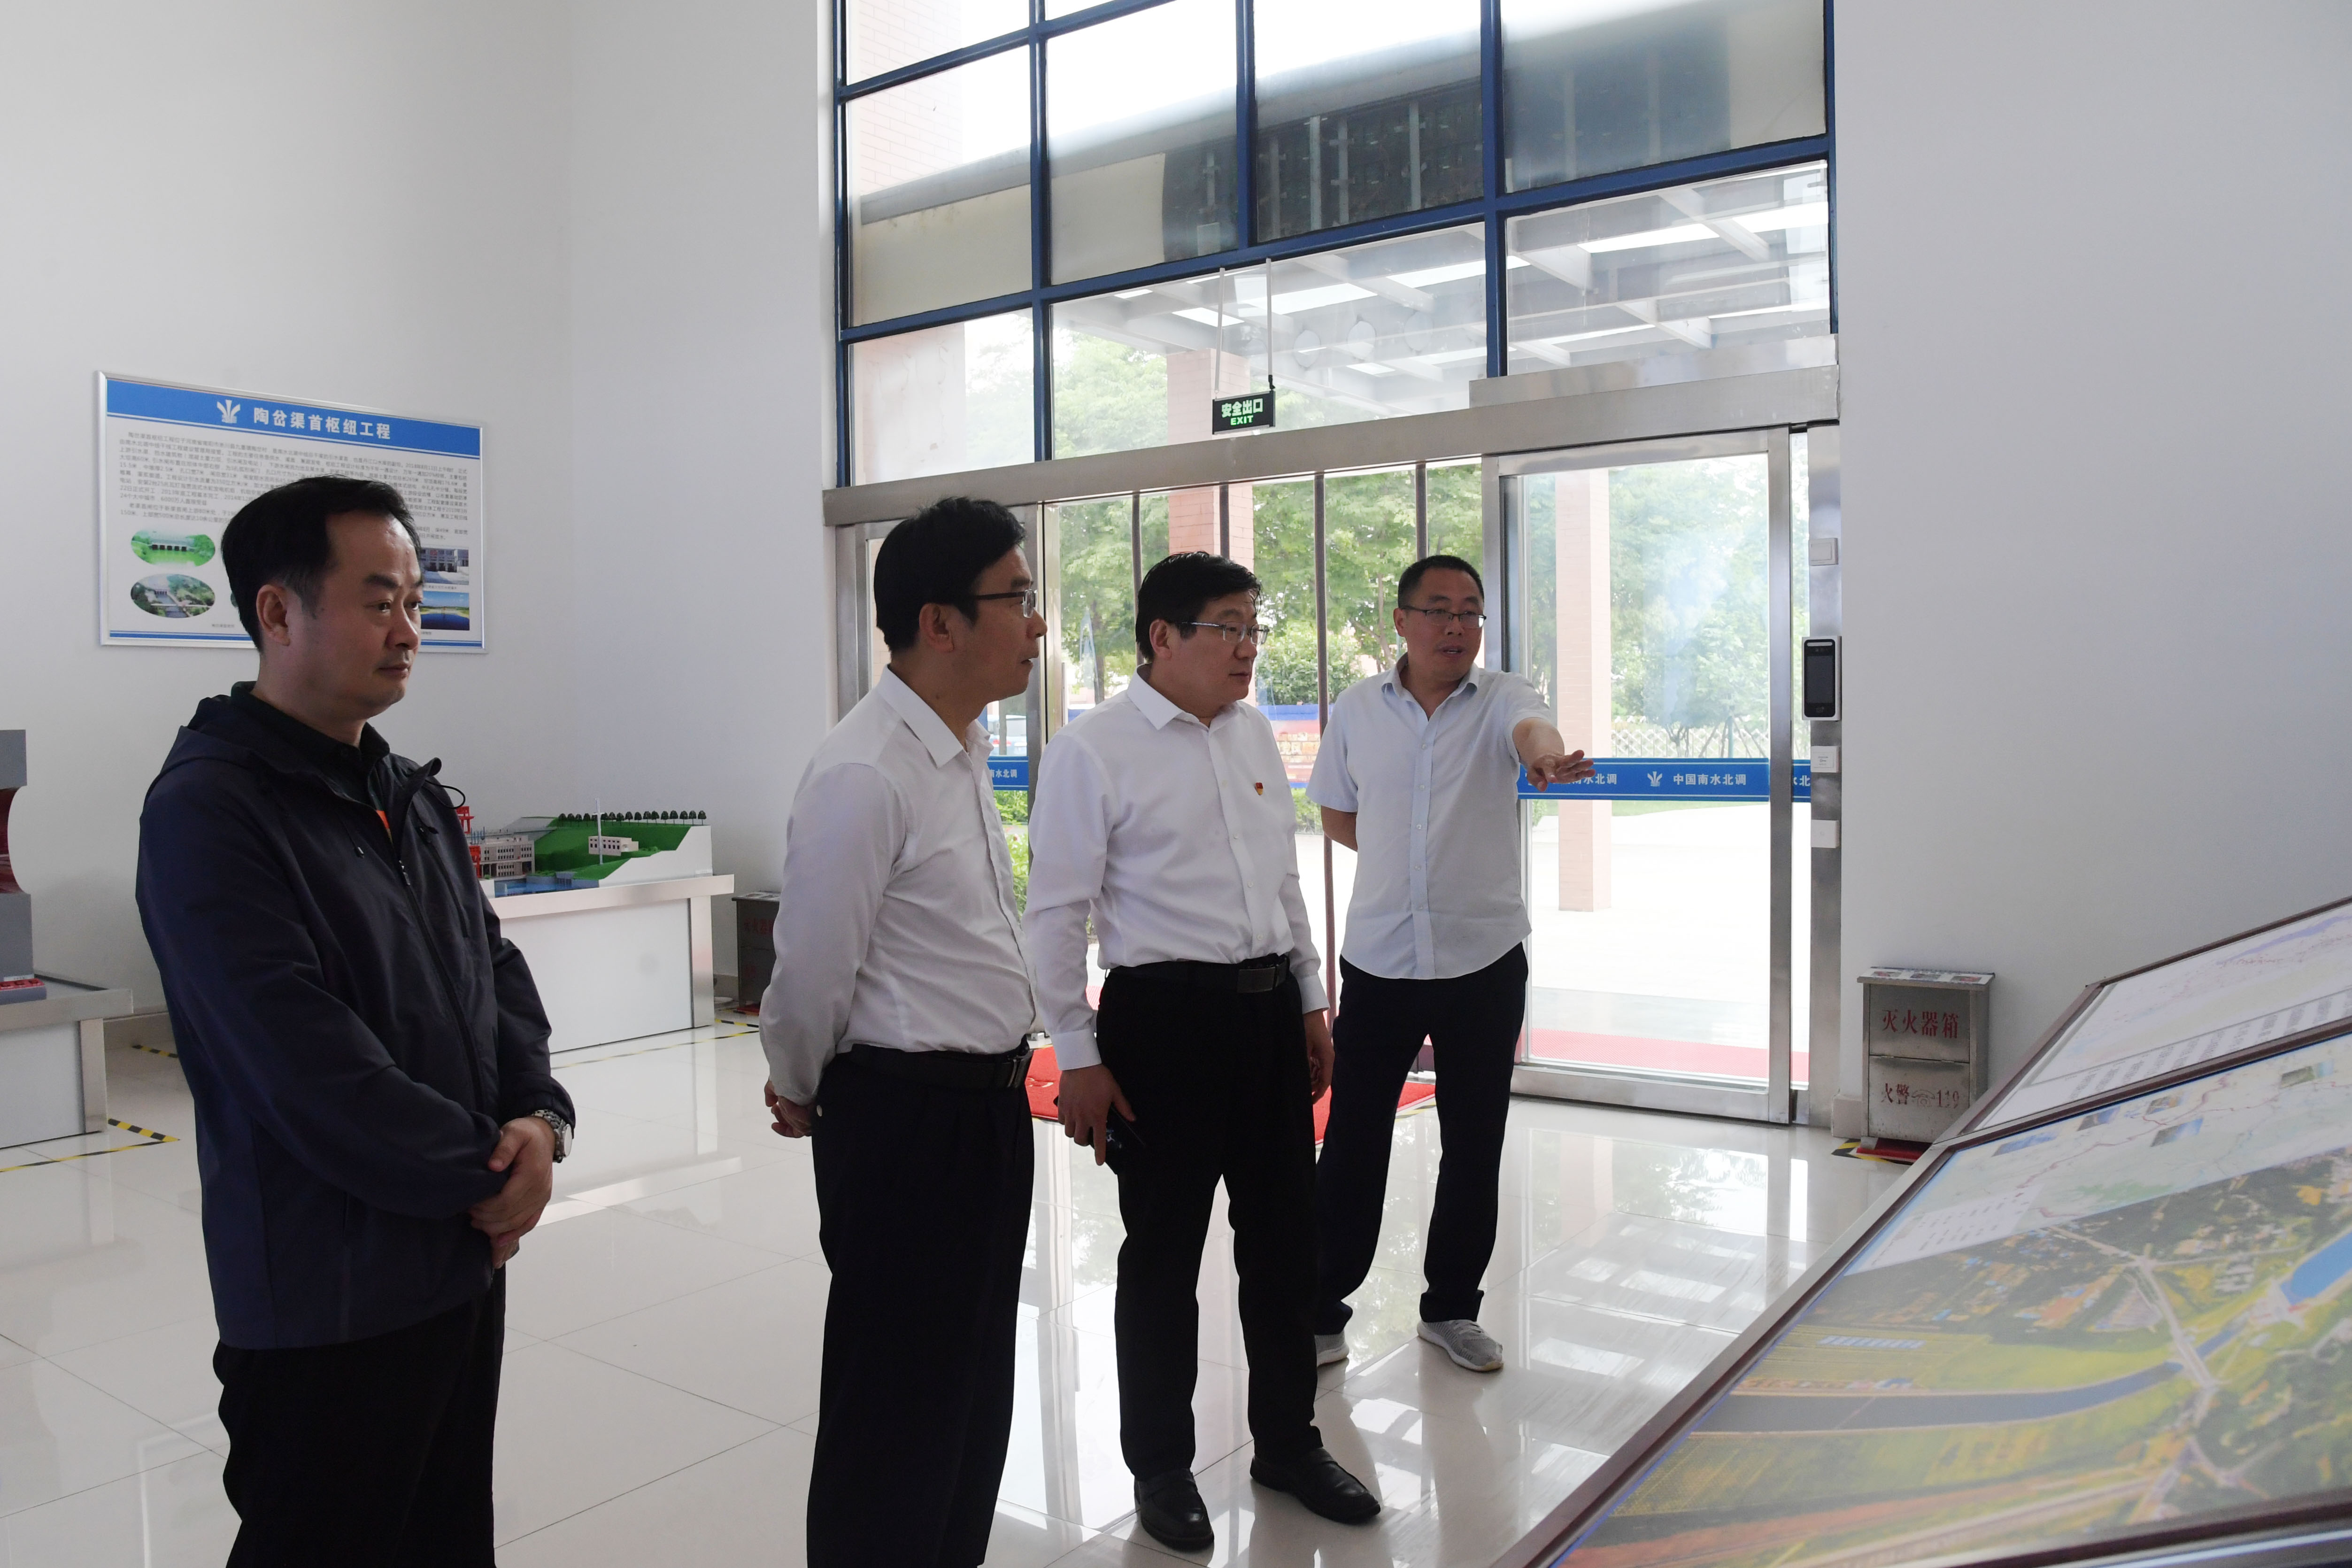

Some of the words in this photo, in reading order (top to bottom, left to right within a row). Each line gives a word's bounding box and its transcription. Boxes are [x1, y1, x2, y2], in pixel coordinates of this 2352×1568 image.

[1221, 398, 1263, 418] 安全出口
[254, 407, 391, 440] 陶岔渠首枢纽工程
[1230, 415, 1254, 425] EXIT
[1673, 773, 1746, 786] 中国南水北调
[1882, 1009, 1959, 1039] 灭火器箱
[1881, 1082, 1910, 1105] 火警
[1936, 1089, 1960, 1109] 119
